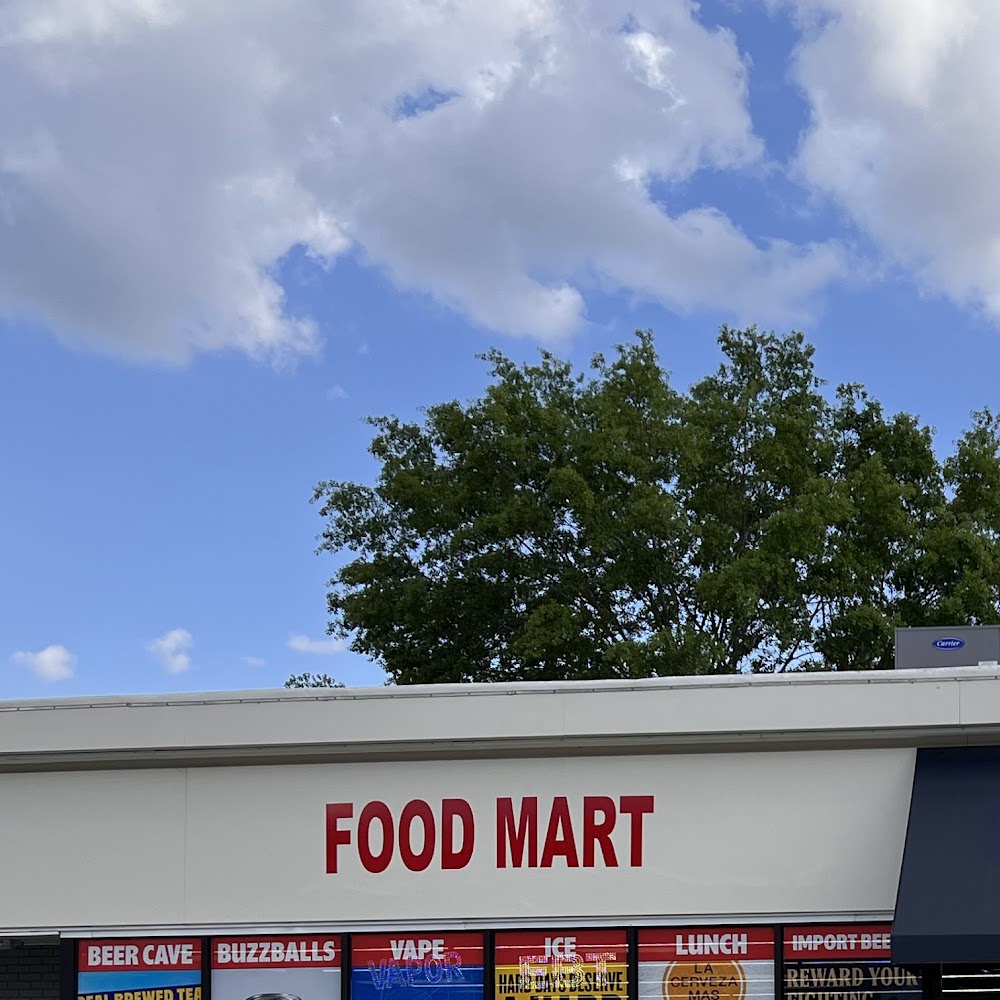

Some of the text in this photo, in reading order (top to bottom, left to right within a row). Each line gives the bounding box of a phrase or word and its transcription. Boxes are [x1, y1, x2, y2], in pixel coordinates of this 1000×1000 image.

[936, 639, 961, 648] Carrier
[325, 795, 655, 874] FOOD MART
[217, 941, 336, 964] BUZZBALLS
[390, 939, 446, 960] VAPE
[544, 936, 577, 959] ICE
[675, 933, 748, 956] LUNCH
[792, 933, 892, 951] IMPORT BEE
[87, 944, 193, 967] BEER CAVE
[367, 951, 465, 990] VAPOR
[694, 963, 714, 974] LA
[786, 966, 919, 988] REWARD YOUR
[669, 976, 738, 988] CERVEZA
[688, 990, 720, 1000] MAS
